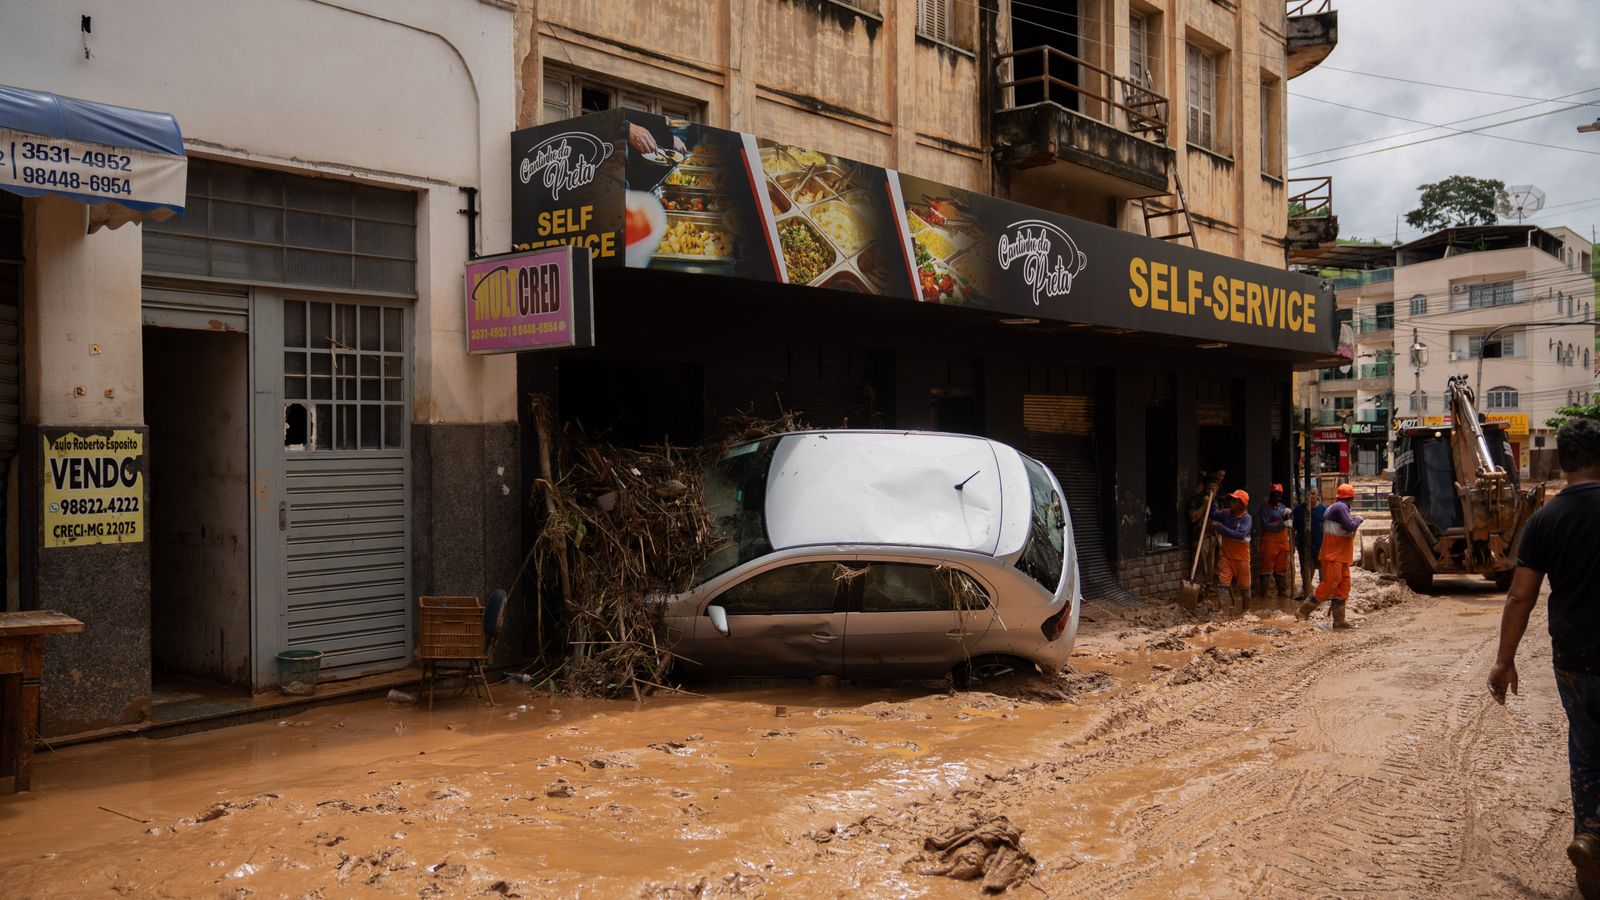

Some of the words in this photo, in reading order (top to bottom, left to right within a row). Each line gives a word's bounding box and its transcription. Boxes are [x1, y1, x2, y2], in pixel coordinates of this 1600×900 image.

[22, 141, 132, 172] 3531-4952
[23, 166, 132, 195] 98448-6954
[543, 153, 596, 201] Preta
[537, 205, 593, 236] SELF
[1024, 252, 1072, 306] Preta
[1129, 256, 1316, 334] SELF-SERVICE
[73, 438, 104, 451] Roberto
[106, 437, 138, 453] Esposito
[50, 456, 138, 490] VENDO
[61, 497, 139, 515] 98822.4222
[53, 523, 104, 538] CRECI-MG
[106, 521, 136, 535] 22075
